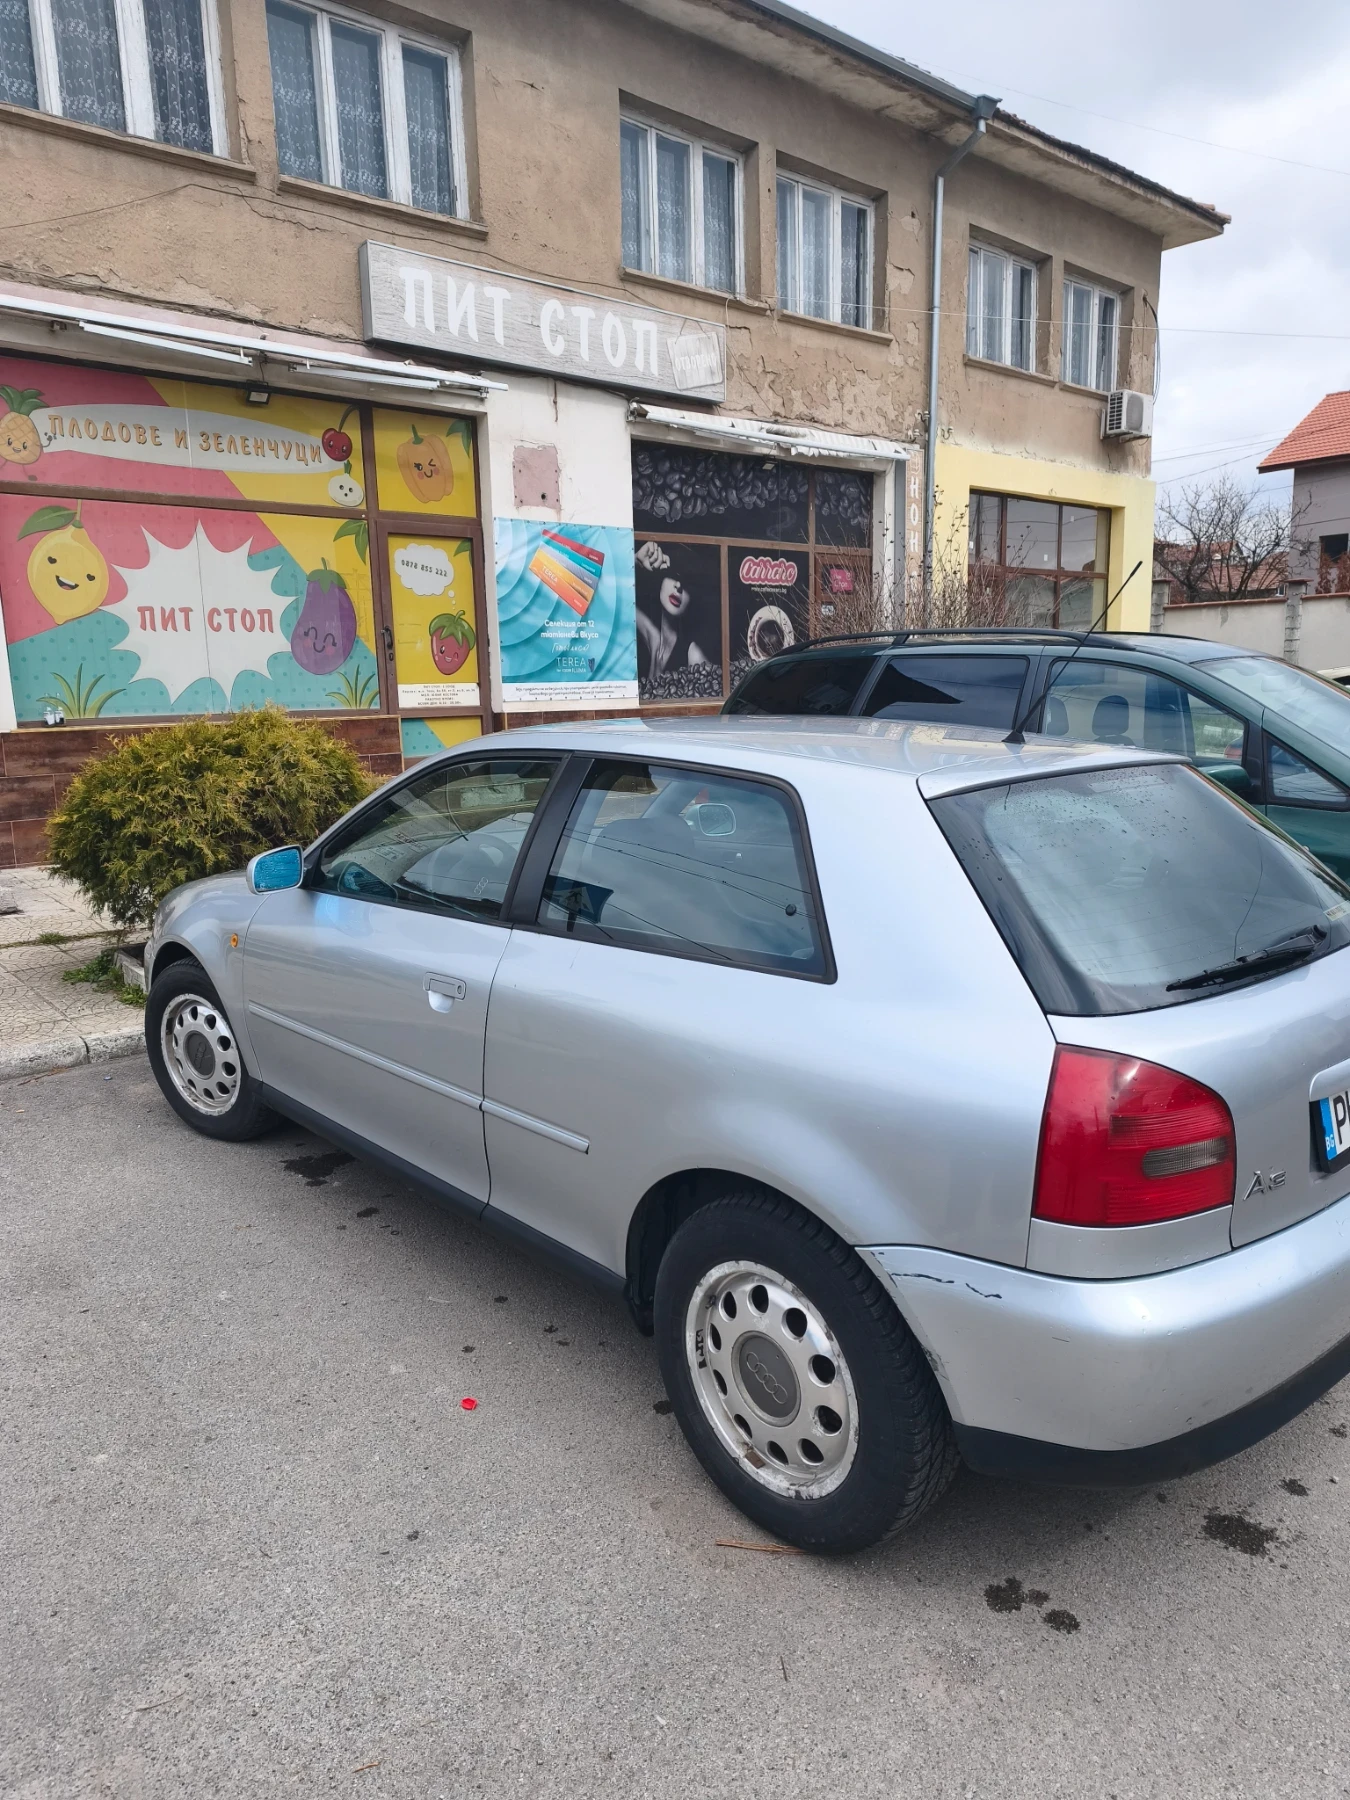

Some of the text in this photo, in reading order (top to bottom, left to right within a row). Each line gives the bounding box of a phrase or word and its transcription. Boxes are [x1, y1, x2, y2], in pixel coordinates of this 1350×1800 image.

[400, 267, 659, 376] ПИТ СТОП
[48, 414, 323, 466] ПЛОДОВЕ И ЗЕЛЕНЧУЦИ
[741, 560, 796, 581] Carraro
[137, 606, 274, 633] ПИТ СТОП
[556, 657, 587, 667] TEREA
[1325, 1134, 1335, 1150] BG
